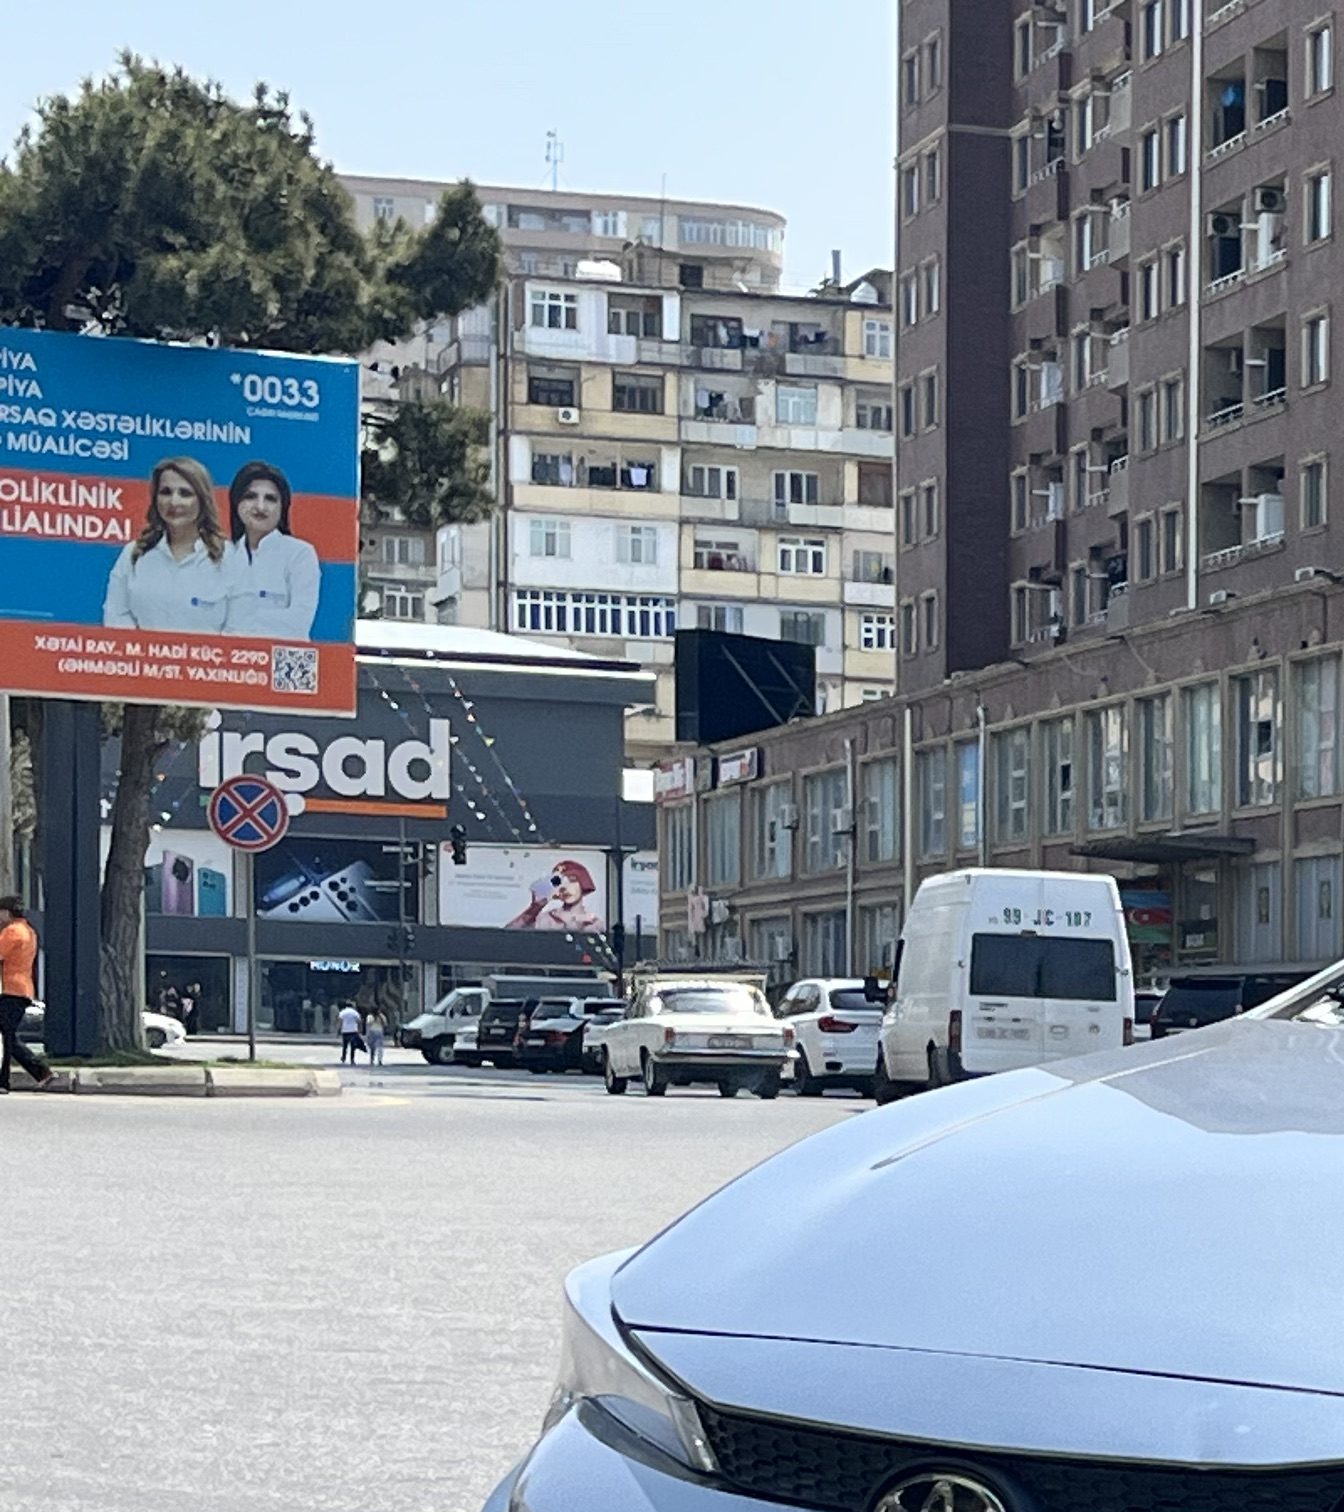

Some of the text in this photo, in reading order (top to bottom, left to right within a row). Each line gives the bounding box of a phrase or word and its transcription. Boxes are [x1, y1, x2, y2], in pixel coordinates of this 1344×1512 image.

[0, 346, 37, 371] İYA
[61, 409, 251, 445] XƏSTƏLİKLƏRİNİN
[7, 431, 129, 461] MÜALİCƏSİ
